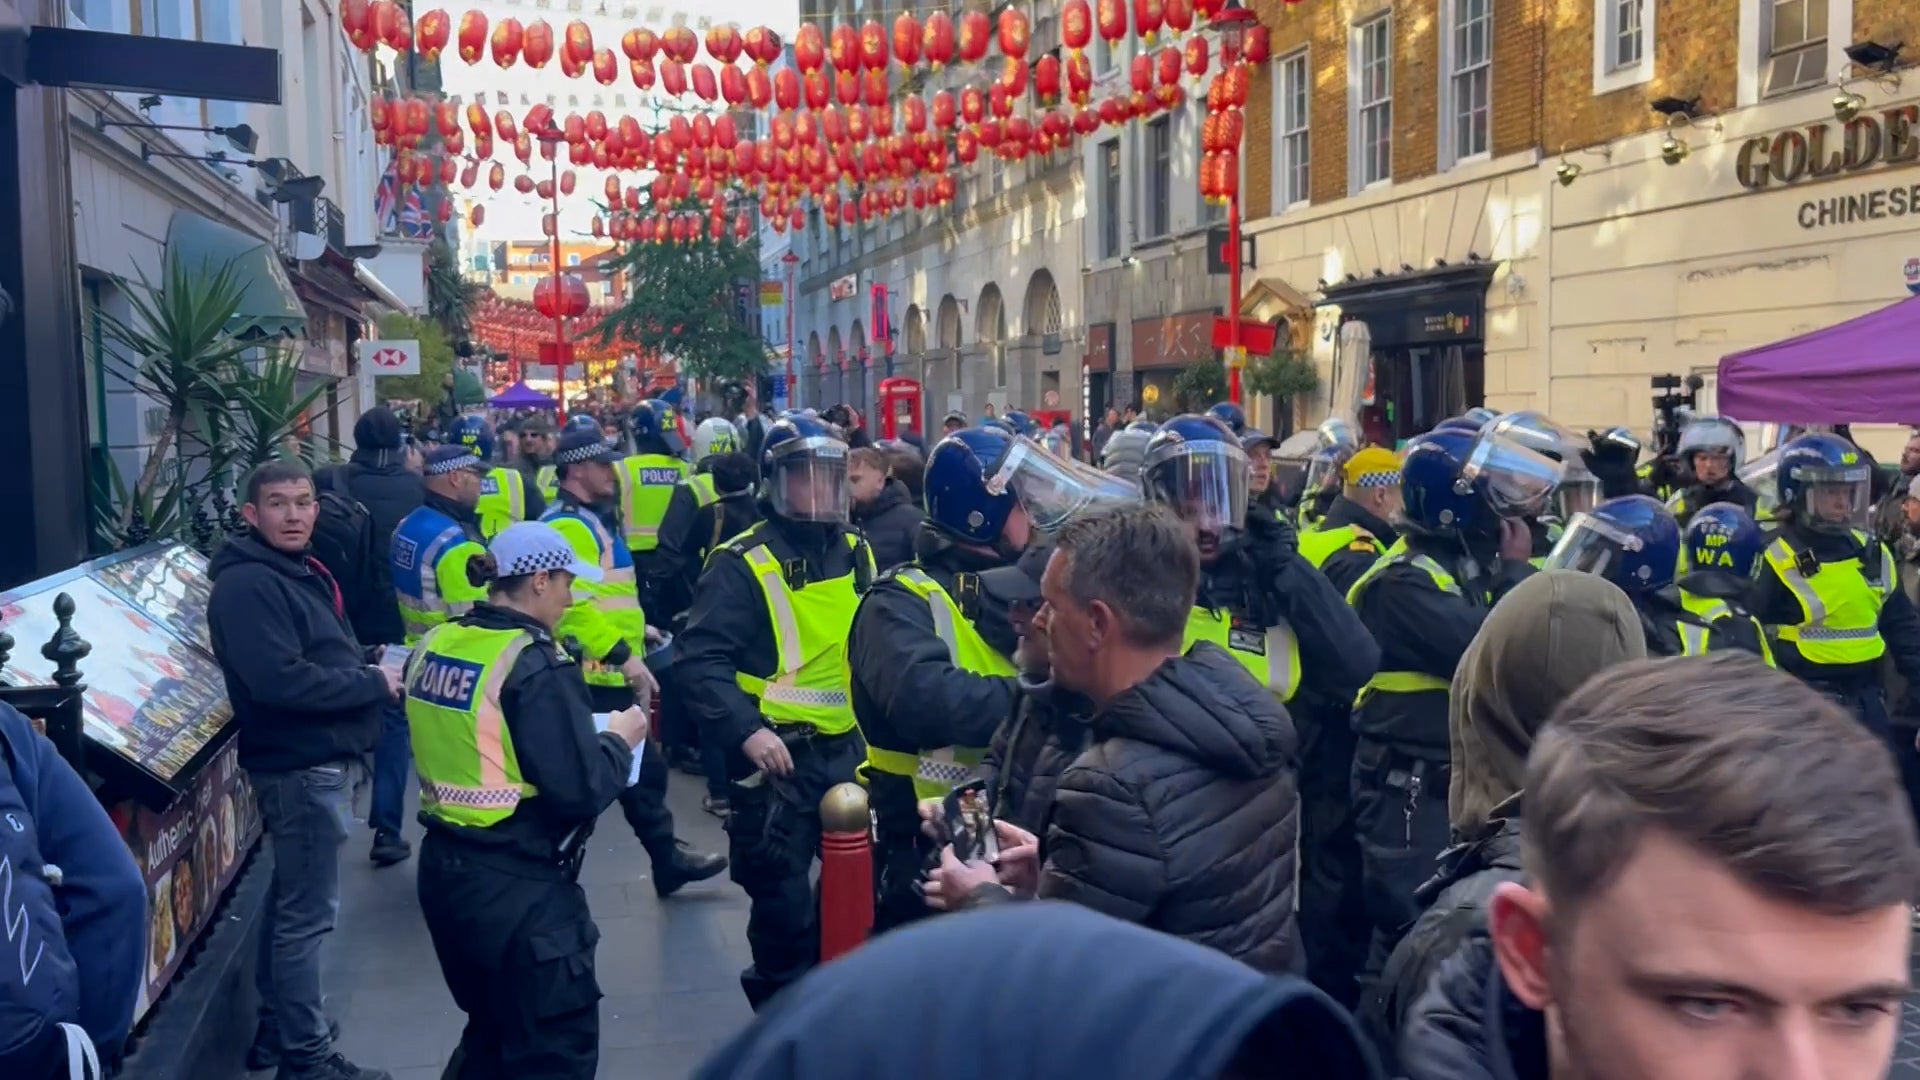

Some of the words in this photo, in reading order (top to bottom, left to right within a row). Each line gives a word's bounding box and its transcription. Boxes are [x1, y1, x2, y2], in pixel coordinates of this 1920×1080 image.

[1736, 105, 1920, 190] GOLDE
[1798, 184, 1920, 229] CHINESE
[1706, 534, 1728, 547] MP
